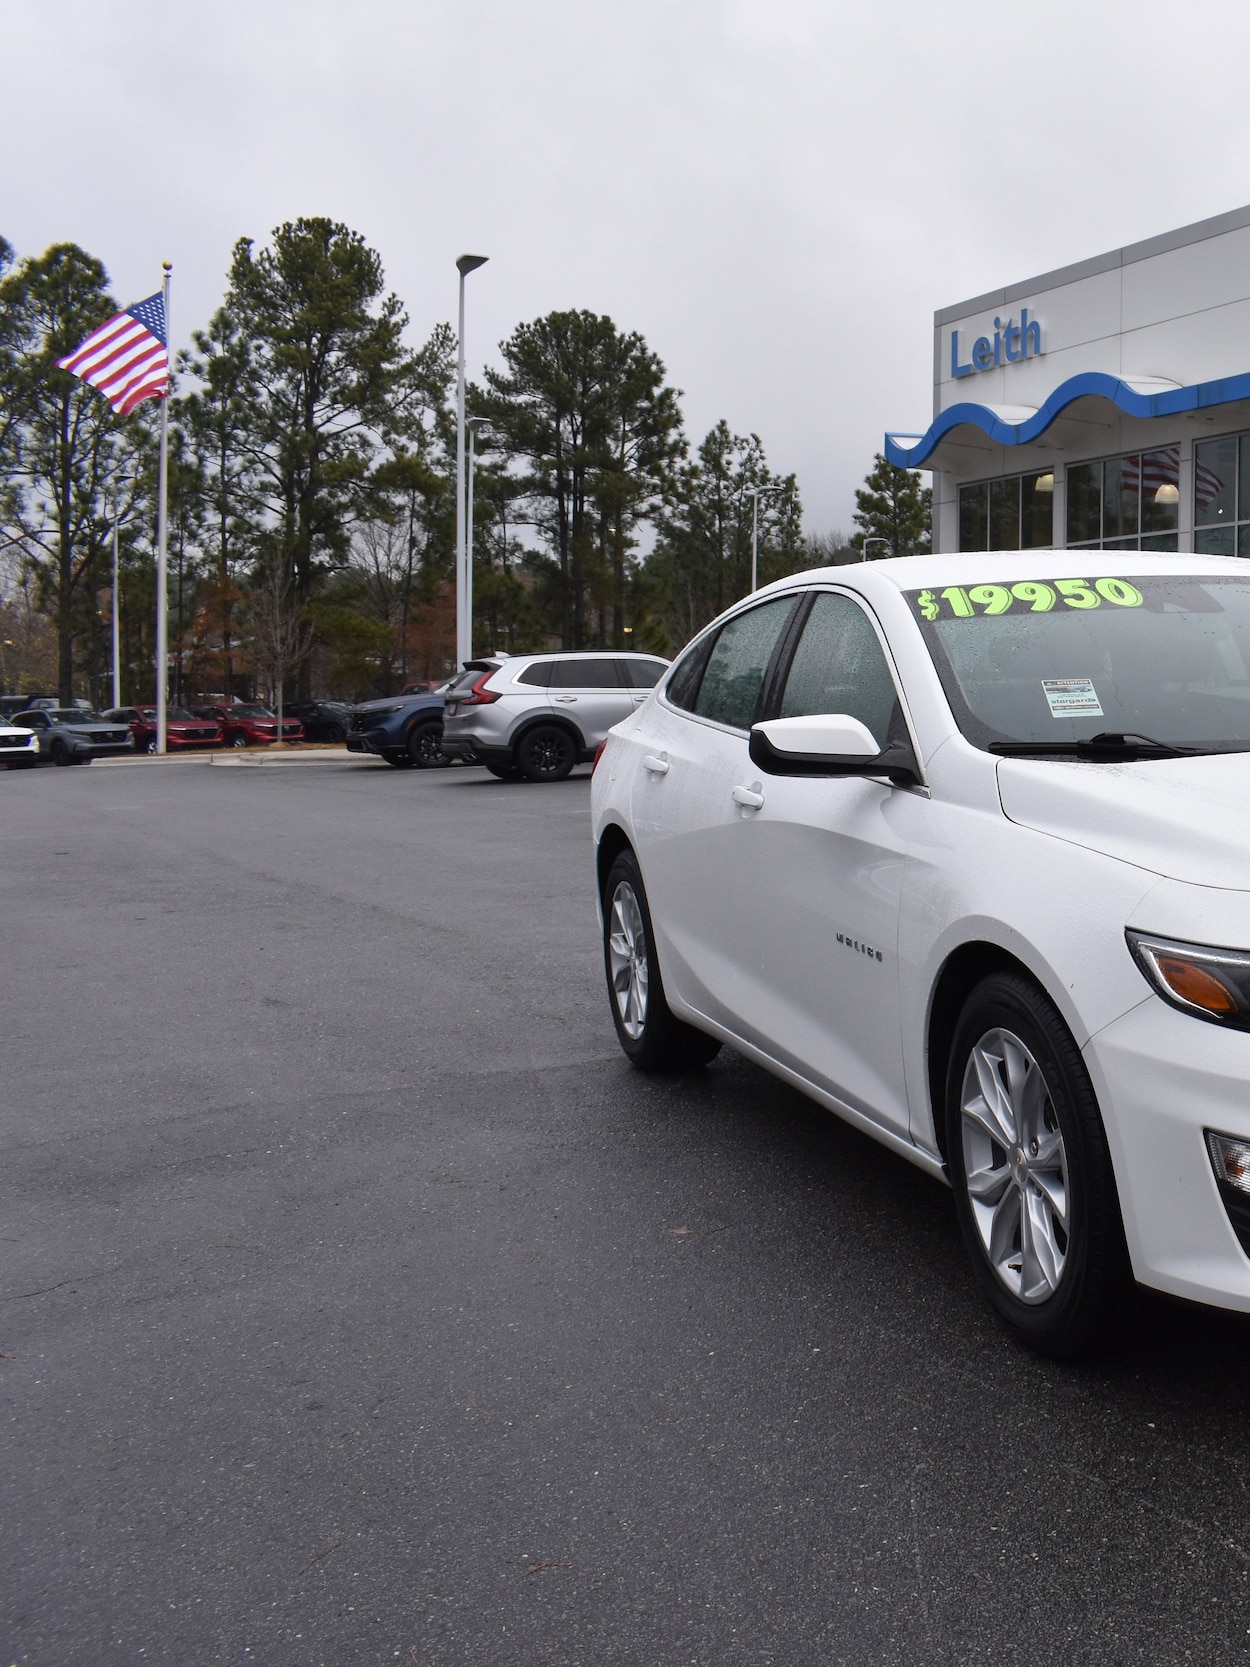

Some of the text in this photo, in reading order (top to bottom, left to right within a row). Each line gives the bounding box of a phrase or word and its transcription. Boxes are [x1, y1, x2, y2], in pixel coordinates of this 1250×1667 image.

[951, 307, 1042, 378] Leith
[917, 578, 1143, 621] $19950
[836, 931, 883, 962] MALIBU
